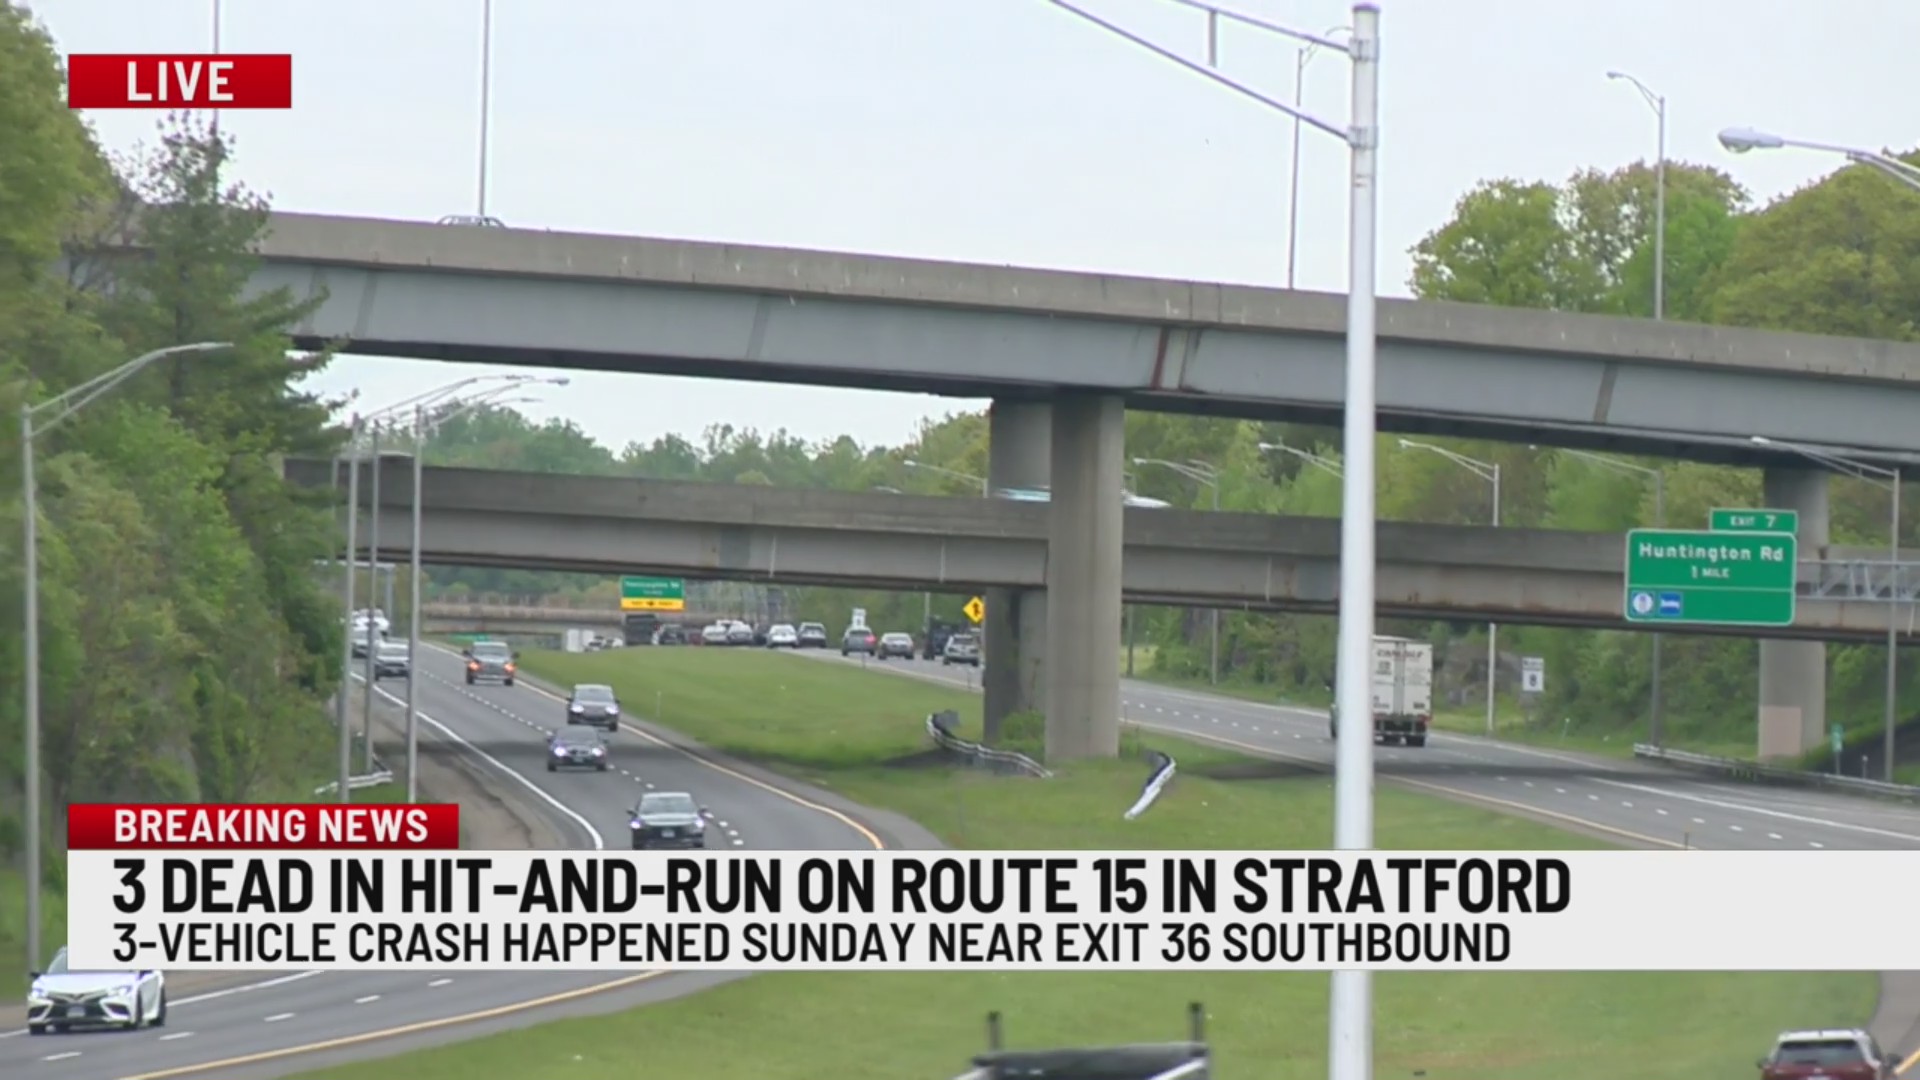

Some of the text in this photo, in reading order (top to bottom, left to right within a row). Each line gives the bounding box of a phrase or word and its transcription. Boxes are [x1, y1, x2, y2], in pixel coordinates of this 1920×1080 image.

[1729, 515, 1776, 528] EXIT 7
[1638, 541, 1785, 563] Huntington Rd
[1702, 568, 1731, 579] MILE
